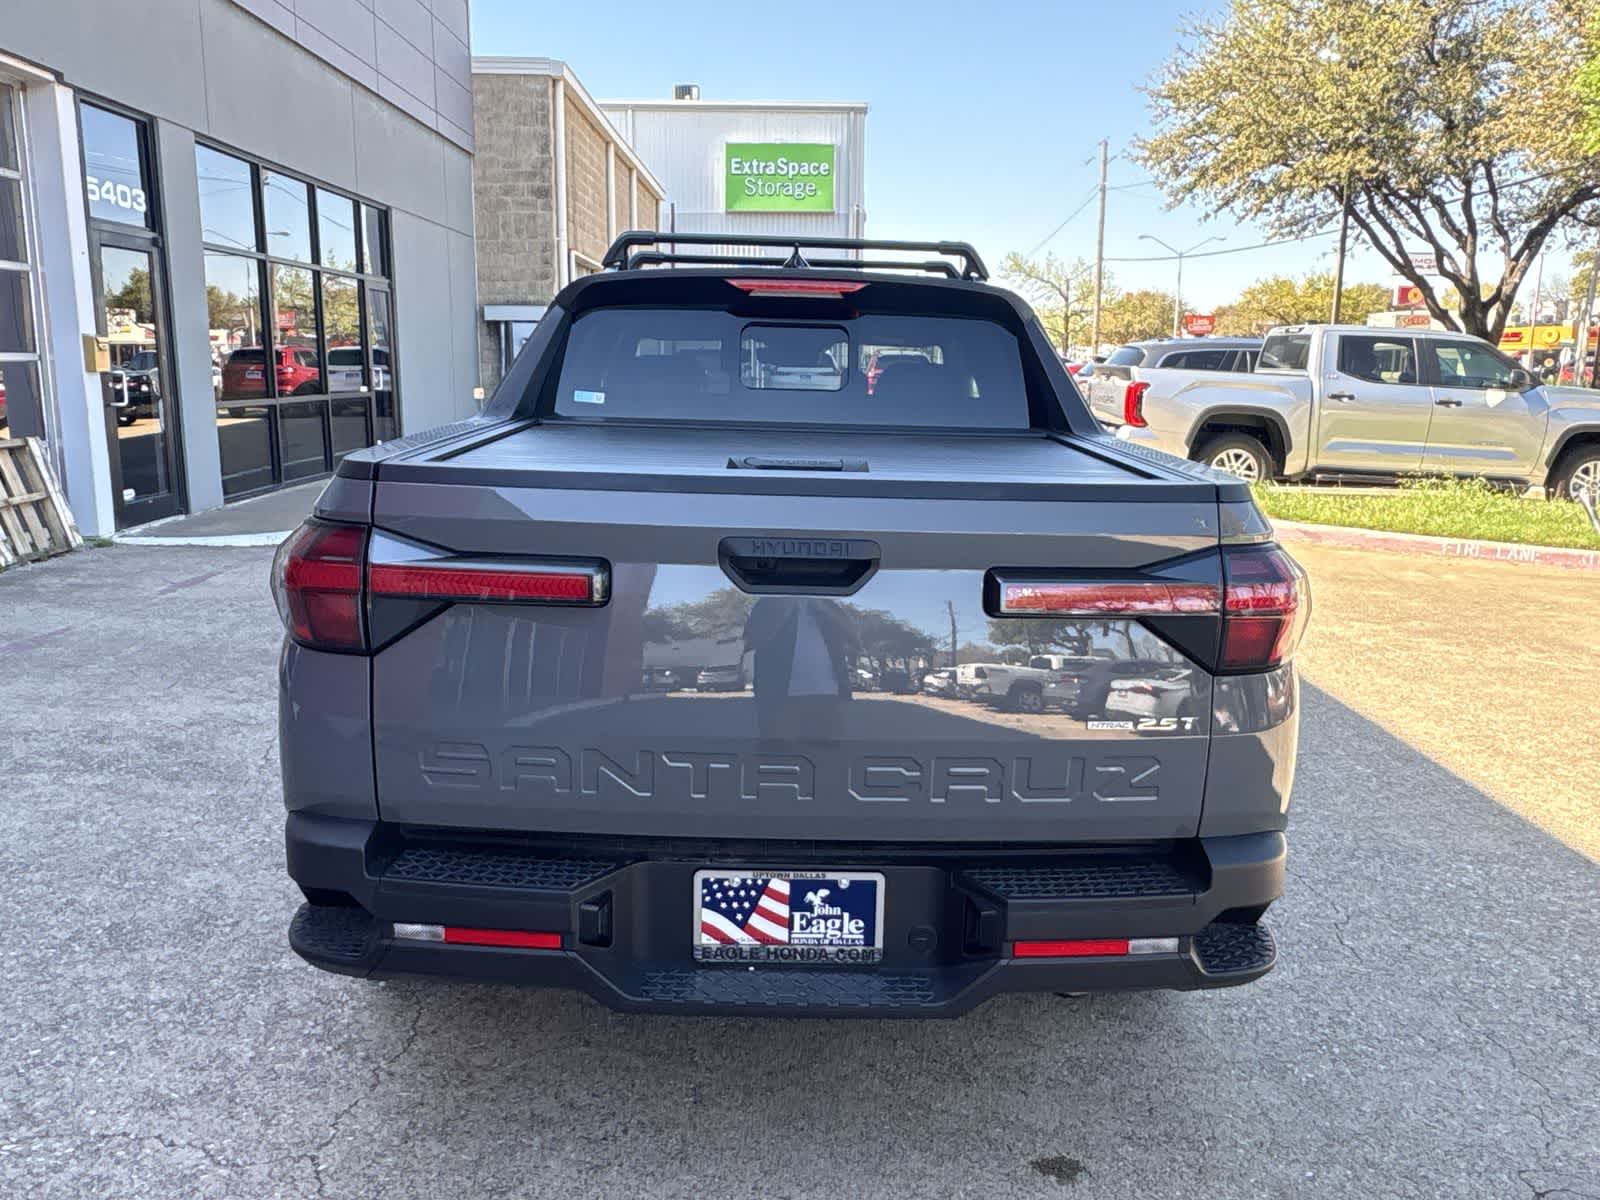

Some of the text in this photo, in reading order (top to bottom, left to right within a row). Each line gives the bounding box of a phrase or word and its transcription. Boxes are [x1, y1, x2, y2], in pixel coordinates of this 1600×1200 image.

[86, 175, 147, 213] 5403
[744, 177, 816, 199] Storage
[751, 540, 849, 556] HYUNDAI
[418, 741, 1162, 803] SANTA CRUZ
[752, 871, 791, 879] UPTOWN
[811, 903, 842, 917] John
[791, 911, 865, 939] Eagle
[701, 946, 766, 960] EAGLE
